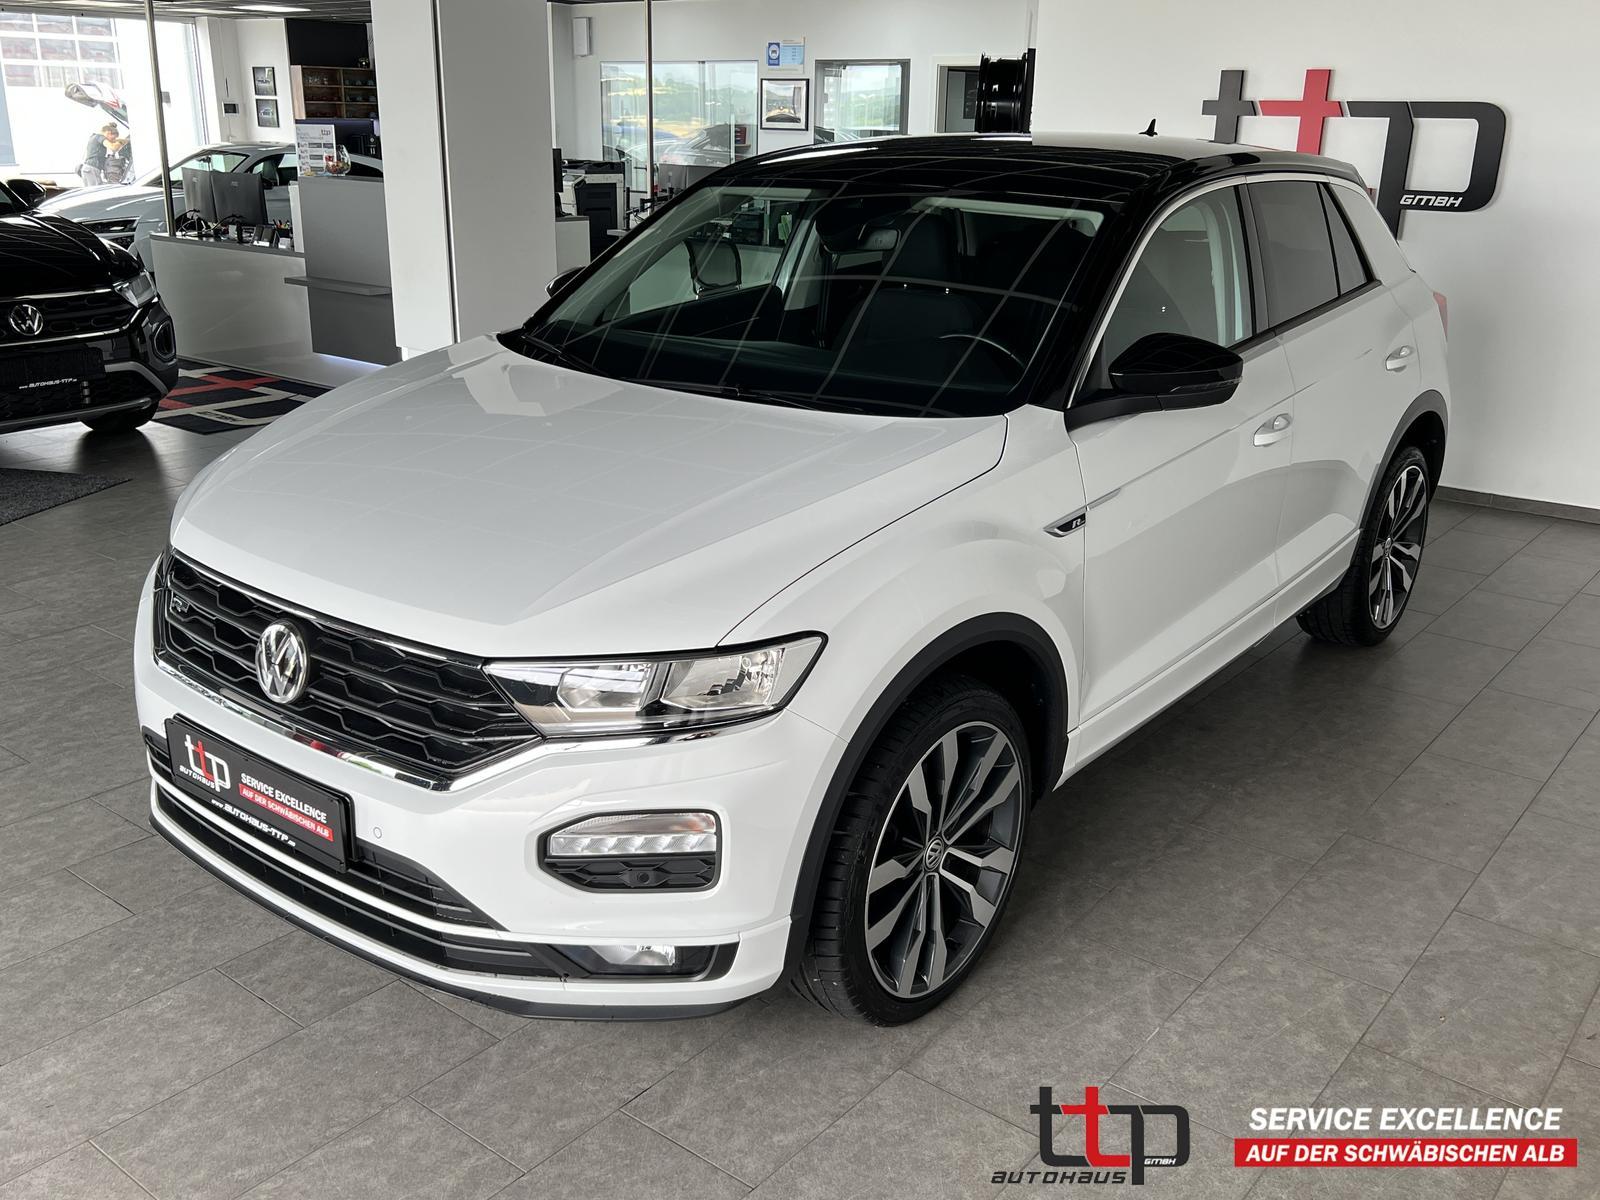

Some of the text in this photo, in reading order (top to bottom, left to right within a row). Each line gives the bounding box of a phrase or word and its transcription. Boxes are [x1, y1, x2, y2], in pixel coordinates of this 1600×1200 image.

[241, 773, 327, 823] SERVICE EXCELLENCE
[242, 788, 254, 800] AUF
[316, 824, 330, 837] ALB
